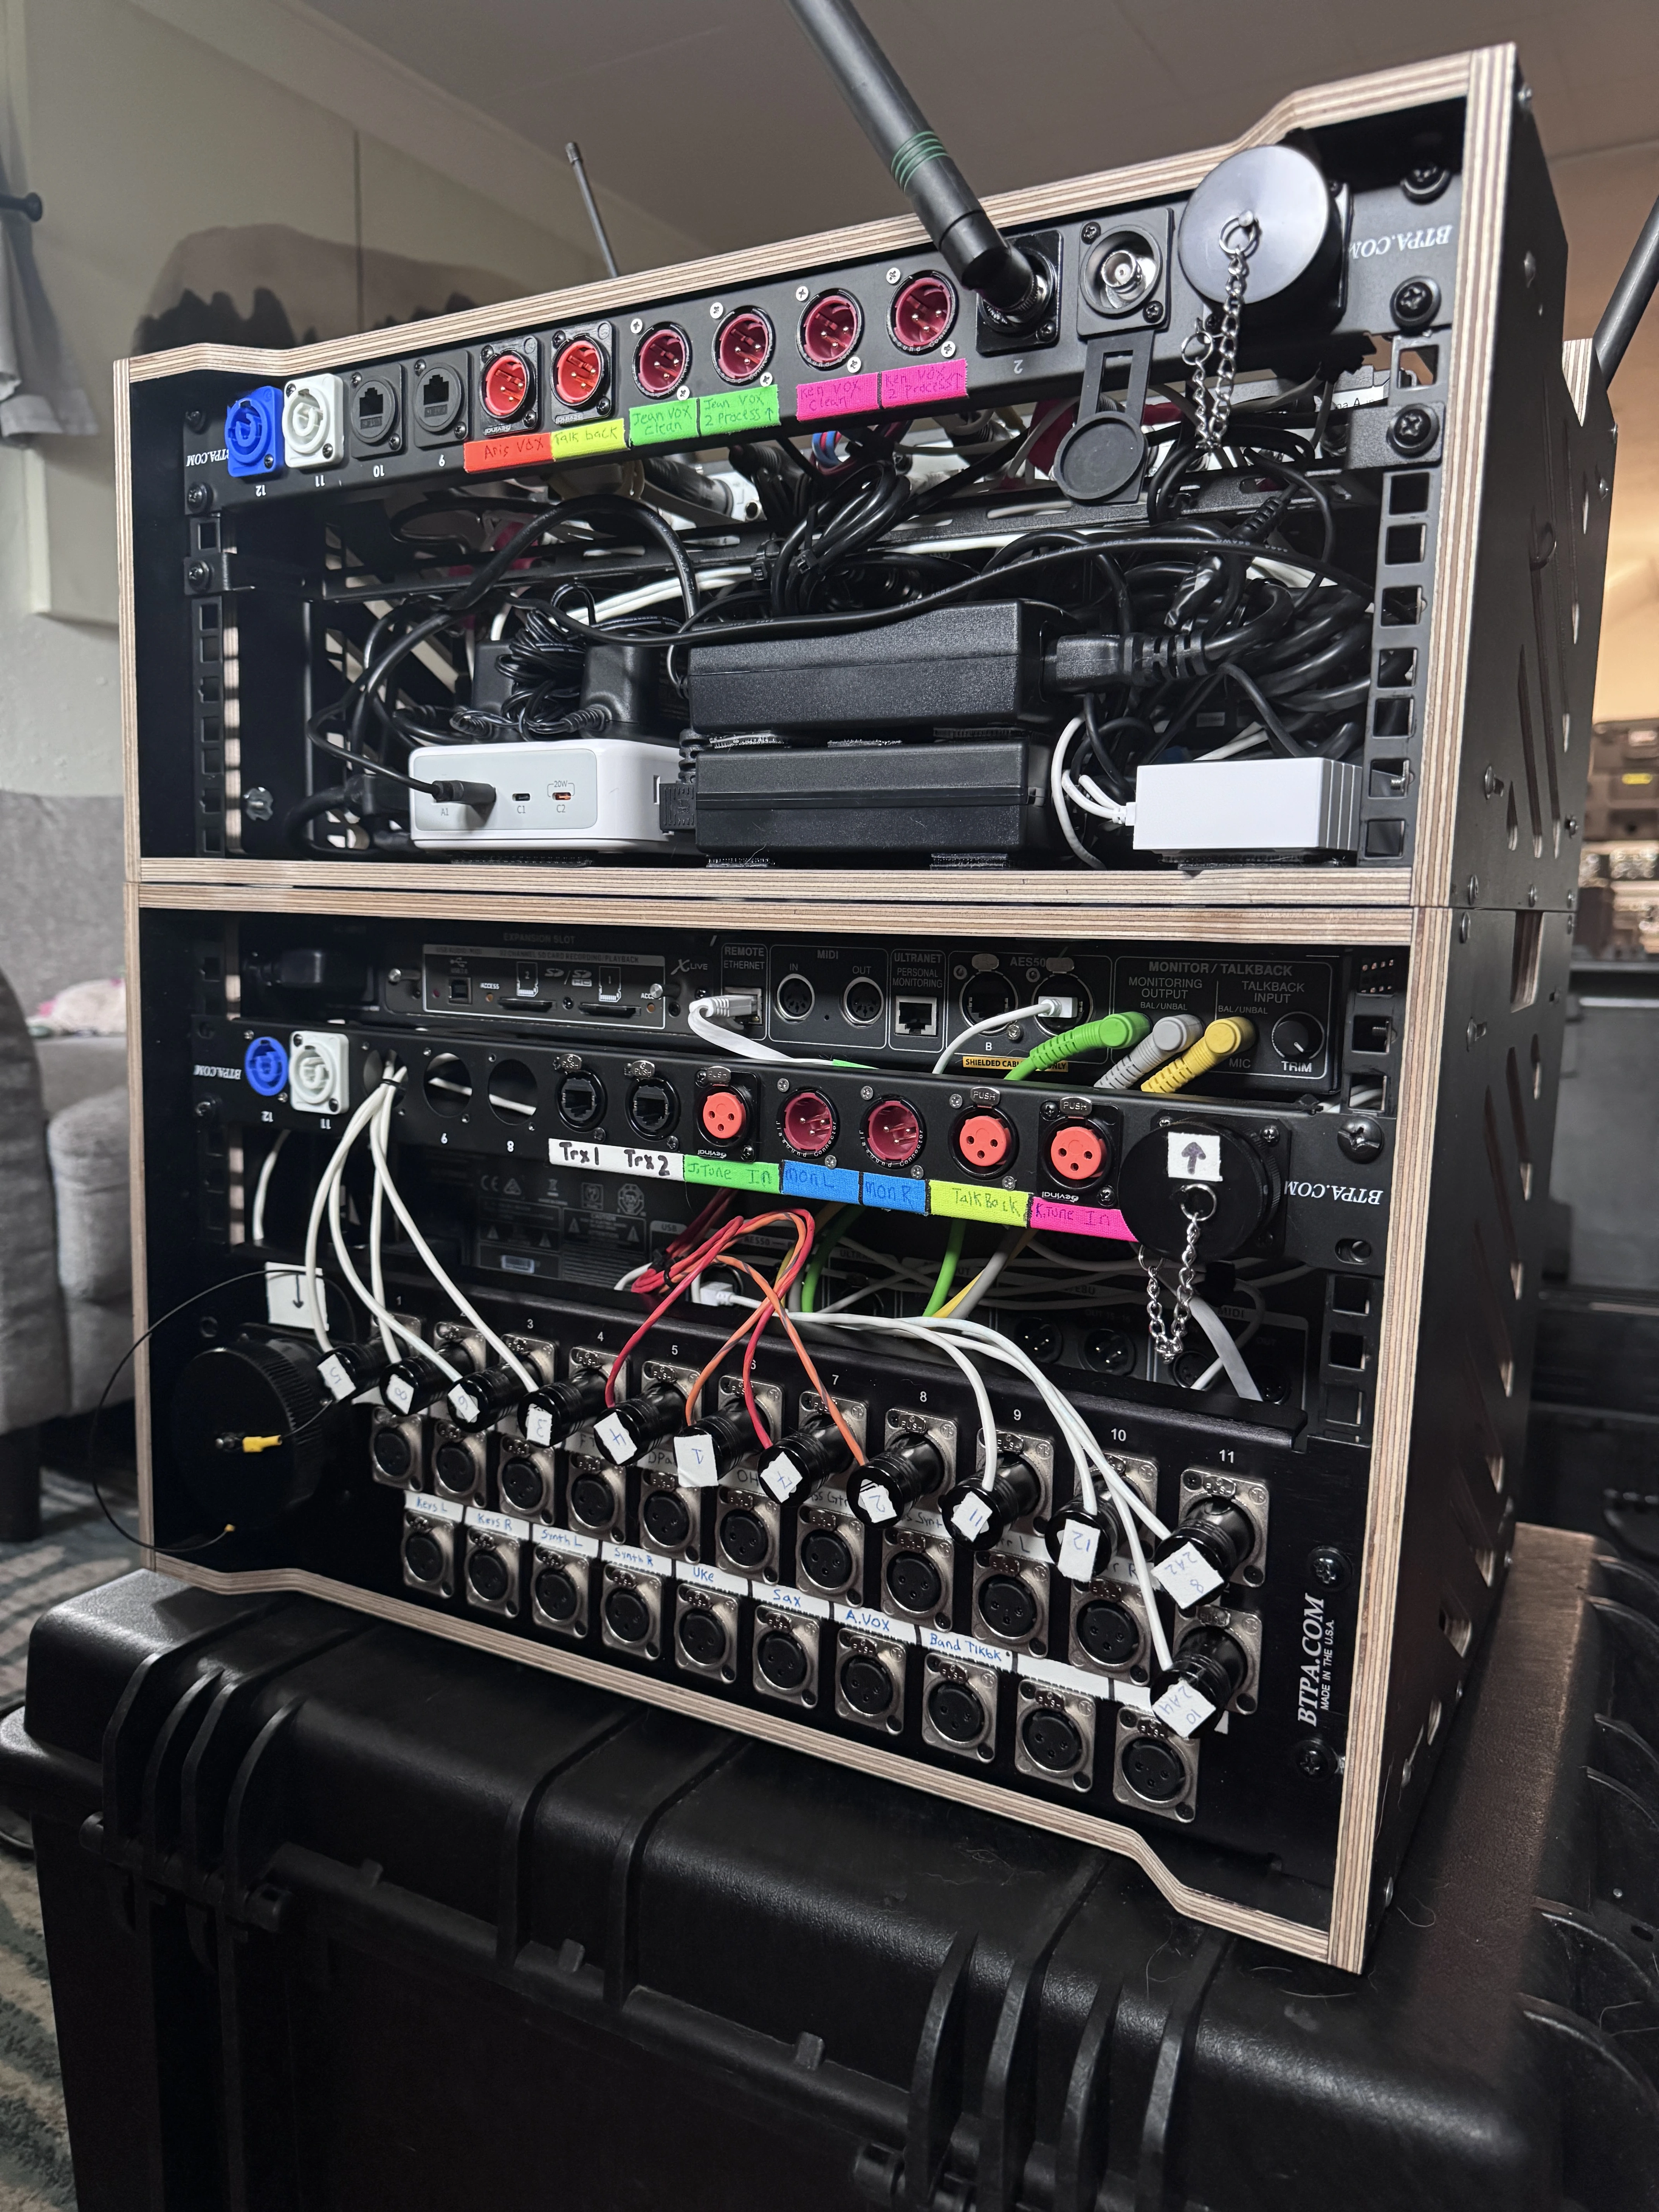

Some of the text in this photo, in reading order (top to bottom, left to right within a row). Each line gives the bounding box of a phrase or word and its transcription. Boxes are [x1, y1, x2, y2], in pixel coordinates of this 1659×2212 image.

[1014, 360, 1024, 374] 2
[704, 398, 730, 410] Jean
[632, 411, 664, 426] Jean
[704, 414, 714, 426] 2
[373, 465, 385, 477] 10
[314, 475, 325, 487] 11
[255, 484, 266, 497] 12
[441, 808, 449, 816] A1
[517, 805, 526, 814] C1
[556, 804, 566, 813] C2
[724, 946, 765, 957] REMOTE
[817, 950, 839, 960] MIDI
[894, 953, 942, 964] ULTRANET
[1009, 957, 1046, 967] AES50
[723, 960, 765, 970] ETHERNET
[789, 963, 798, 971] IN
[852, 966, 872, 974] OUT
[1149, 962, 1293, 977] MONITOR TALKBACK
[897, 967, 939, 978] PERSONAL
[892, 978, 943, 988] MONITORING
[1128, 977, 1203, 989] MONITORING
[1242, 981, 1305, 993] TALKBACK
[1141, 988, 1188, 1000] OUTPUT
[1254, 993, 1291, 1004] INPUT
[1140, 1001, 1188, 1011] BAL/UNBAL
[1218, 1005, 1268, 1015] BAL/UNBAL
[985, 1042, 993, 1051] B
[965, 1059, 1001, 1067] SHIELDED
[1228, 1058, 1251, 1069] MIC
[1281, 1060, 1312, 1073] TRIM
[193, 1064, 241, 1080] BTPA.COM
[973, 1091, 996, 1101] PUSH
[1063, 1101, 1087, 1111] PUSH
[261, 1111, 273, 1122] 12
[320, 1119, 331, 1130] 11
[507, 1141, 514, 1152] 8
[1284, 1180, 1384, 1204] BTPA.COM
[396, 1296, 401, 1305] 1
[527, 1319, 534, 1329] 3
[597, 1331, 604, 1342] 4
[671, 1345, 678, 1355] 5
[751, 1359, 757, 1370] 6
[832, 1374, 839, 1385] 7
[394, 1387, 407, 1401] 8
[920, 1391, 927, 1403] 8
[1013, 1409, 1022, 1421] 9
[609, 1428, 627, 1445] 4
[1111, 1428, 1127, 1442] 10
[691, 1448, 704, 1465] 1
[1219, 1449, 1235, 1463] 11
[777, 1470, 793, 1490] 7
[416, 1496, 436, 1510] Keys
[868, 1494, 886, 1513] 2
[477, 1513, 512, 1531] Keys R
[917, 1512, 943, 1529] Synt
[541, 1529, 583, 1546] Synth L
[1072, 1530, 1091, 1552] 12
[614, 1547, 654, 1566] Synth R
[1189, 1579, 1205, 1594] 8
[773, 1589, 801, 1607] Sax
[929, 1633, 961, 1652] Band
[1297, 1592, 1324, 1726] BTPA.COM
[1323, 1647, 1333, 1667] THE
[1322, 1669, 1331, 1682] IN
[1321, 1689, 1329, 1710] MADE
